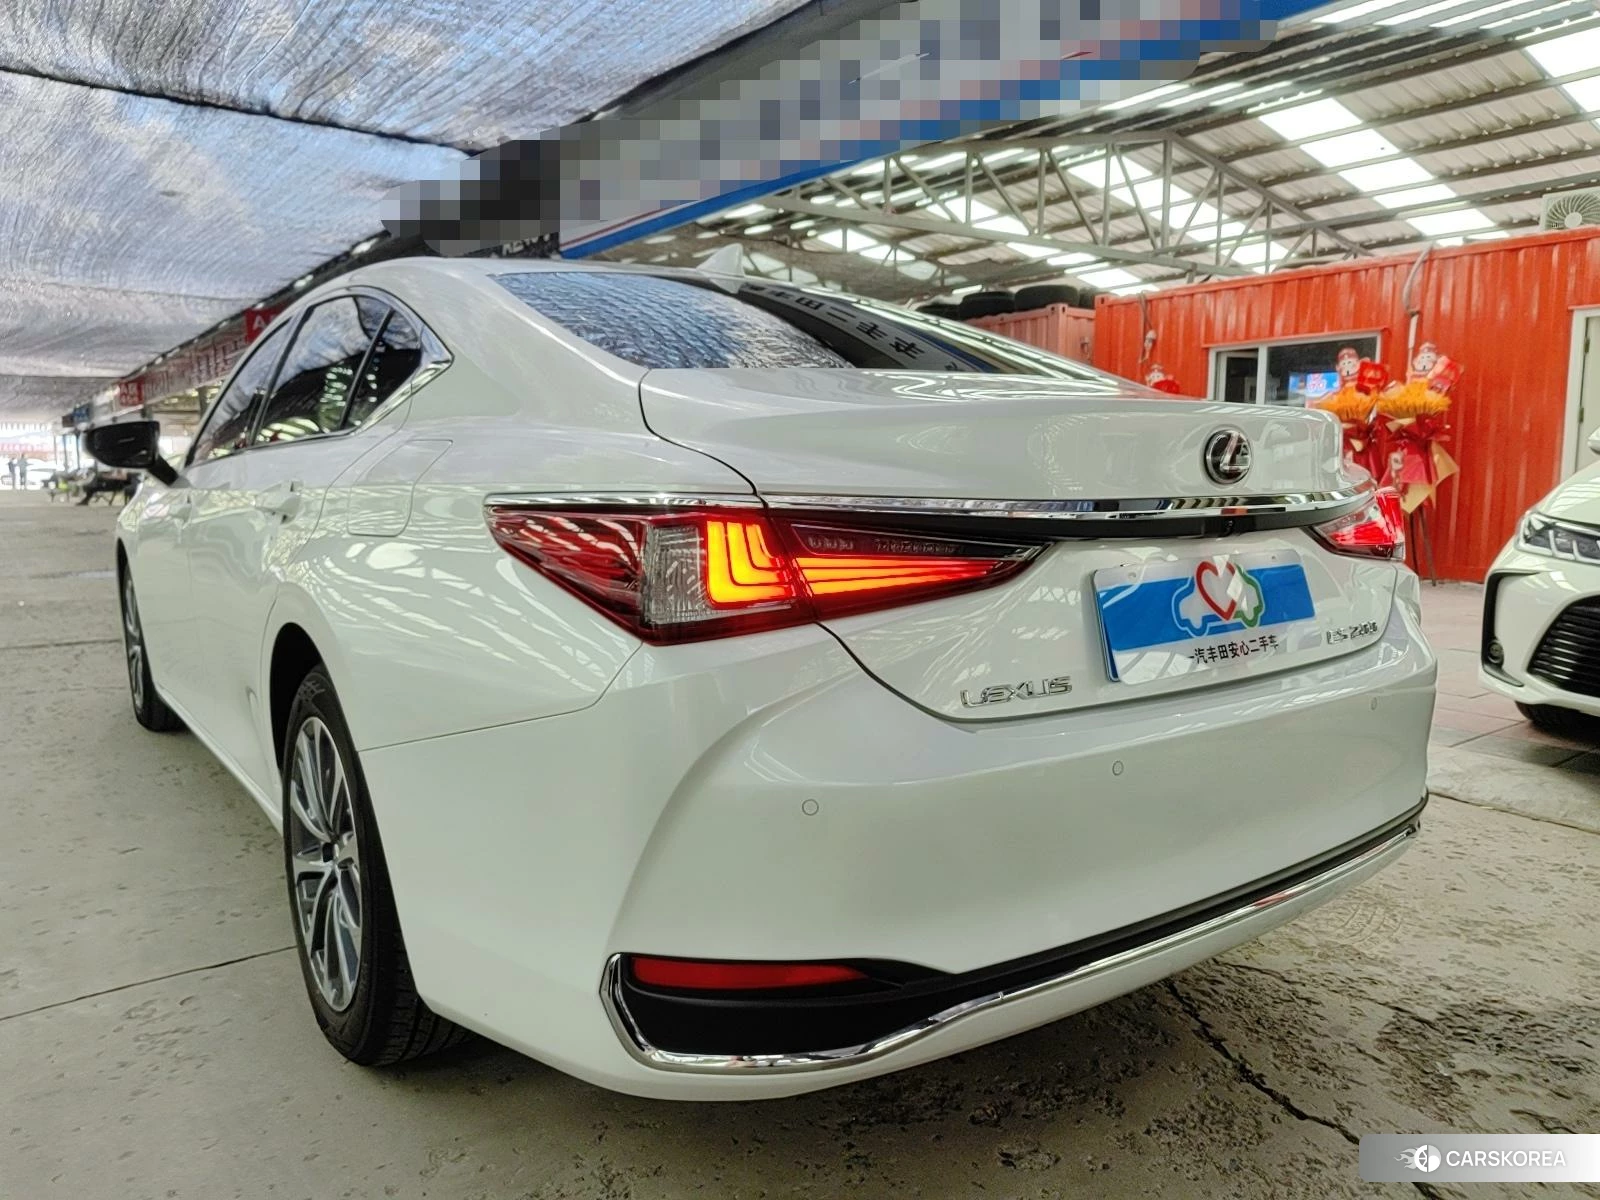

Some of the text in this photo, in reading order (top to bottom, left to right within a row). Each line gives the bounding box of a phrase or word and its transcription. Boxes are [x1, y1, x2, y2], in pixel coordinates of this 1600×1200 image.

[1190, 634, 1279, 664] 一汽丰田安心二手车
[960, 676, 1072, 708] LEXUS
